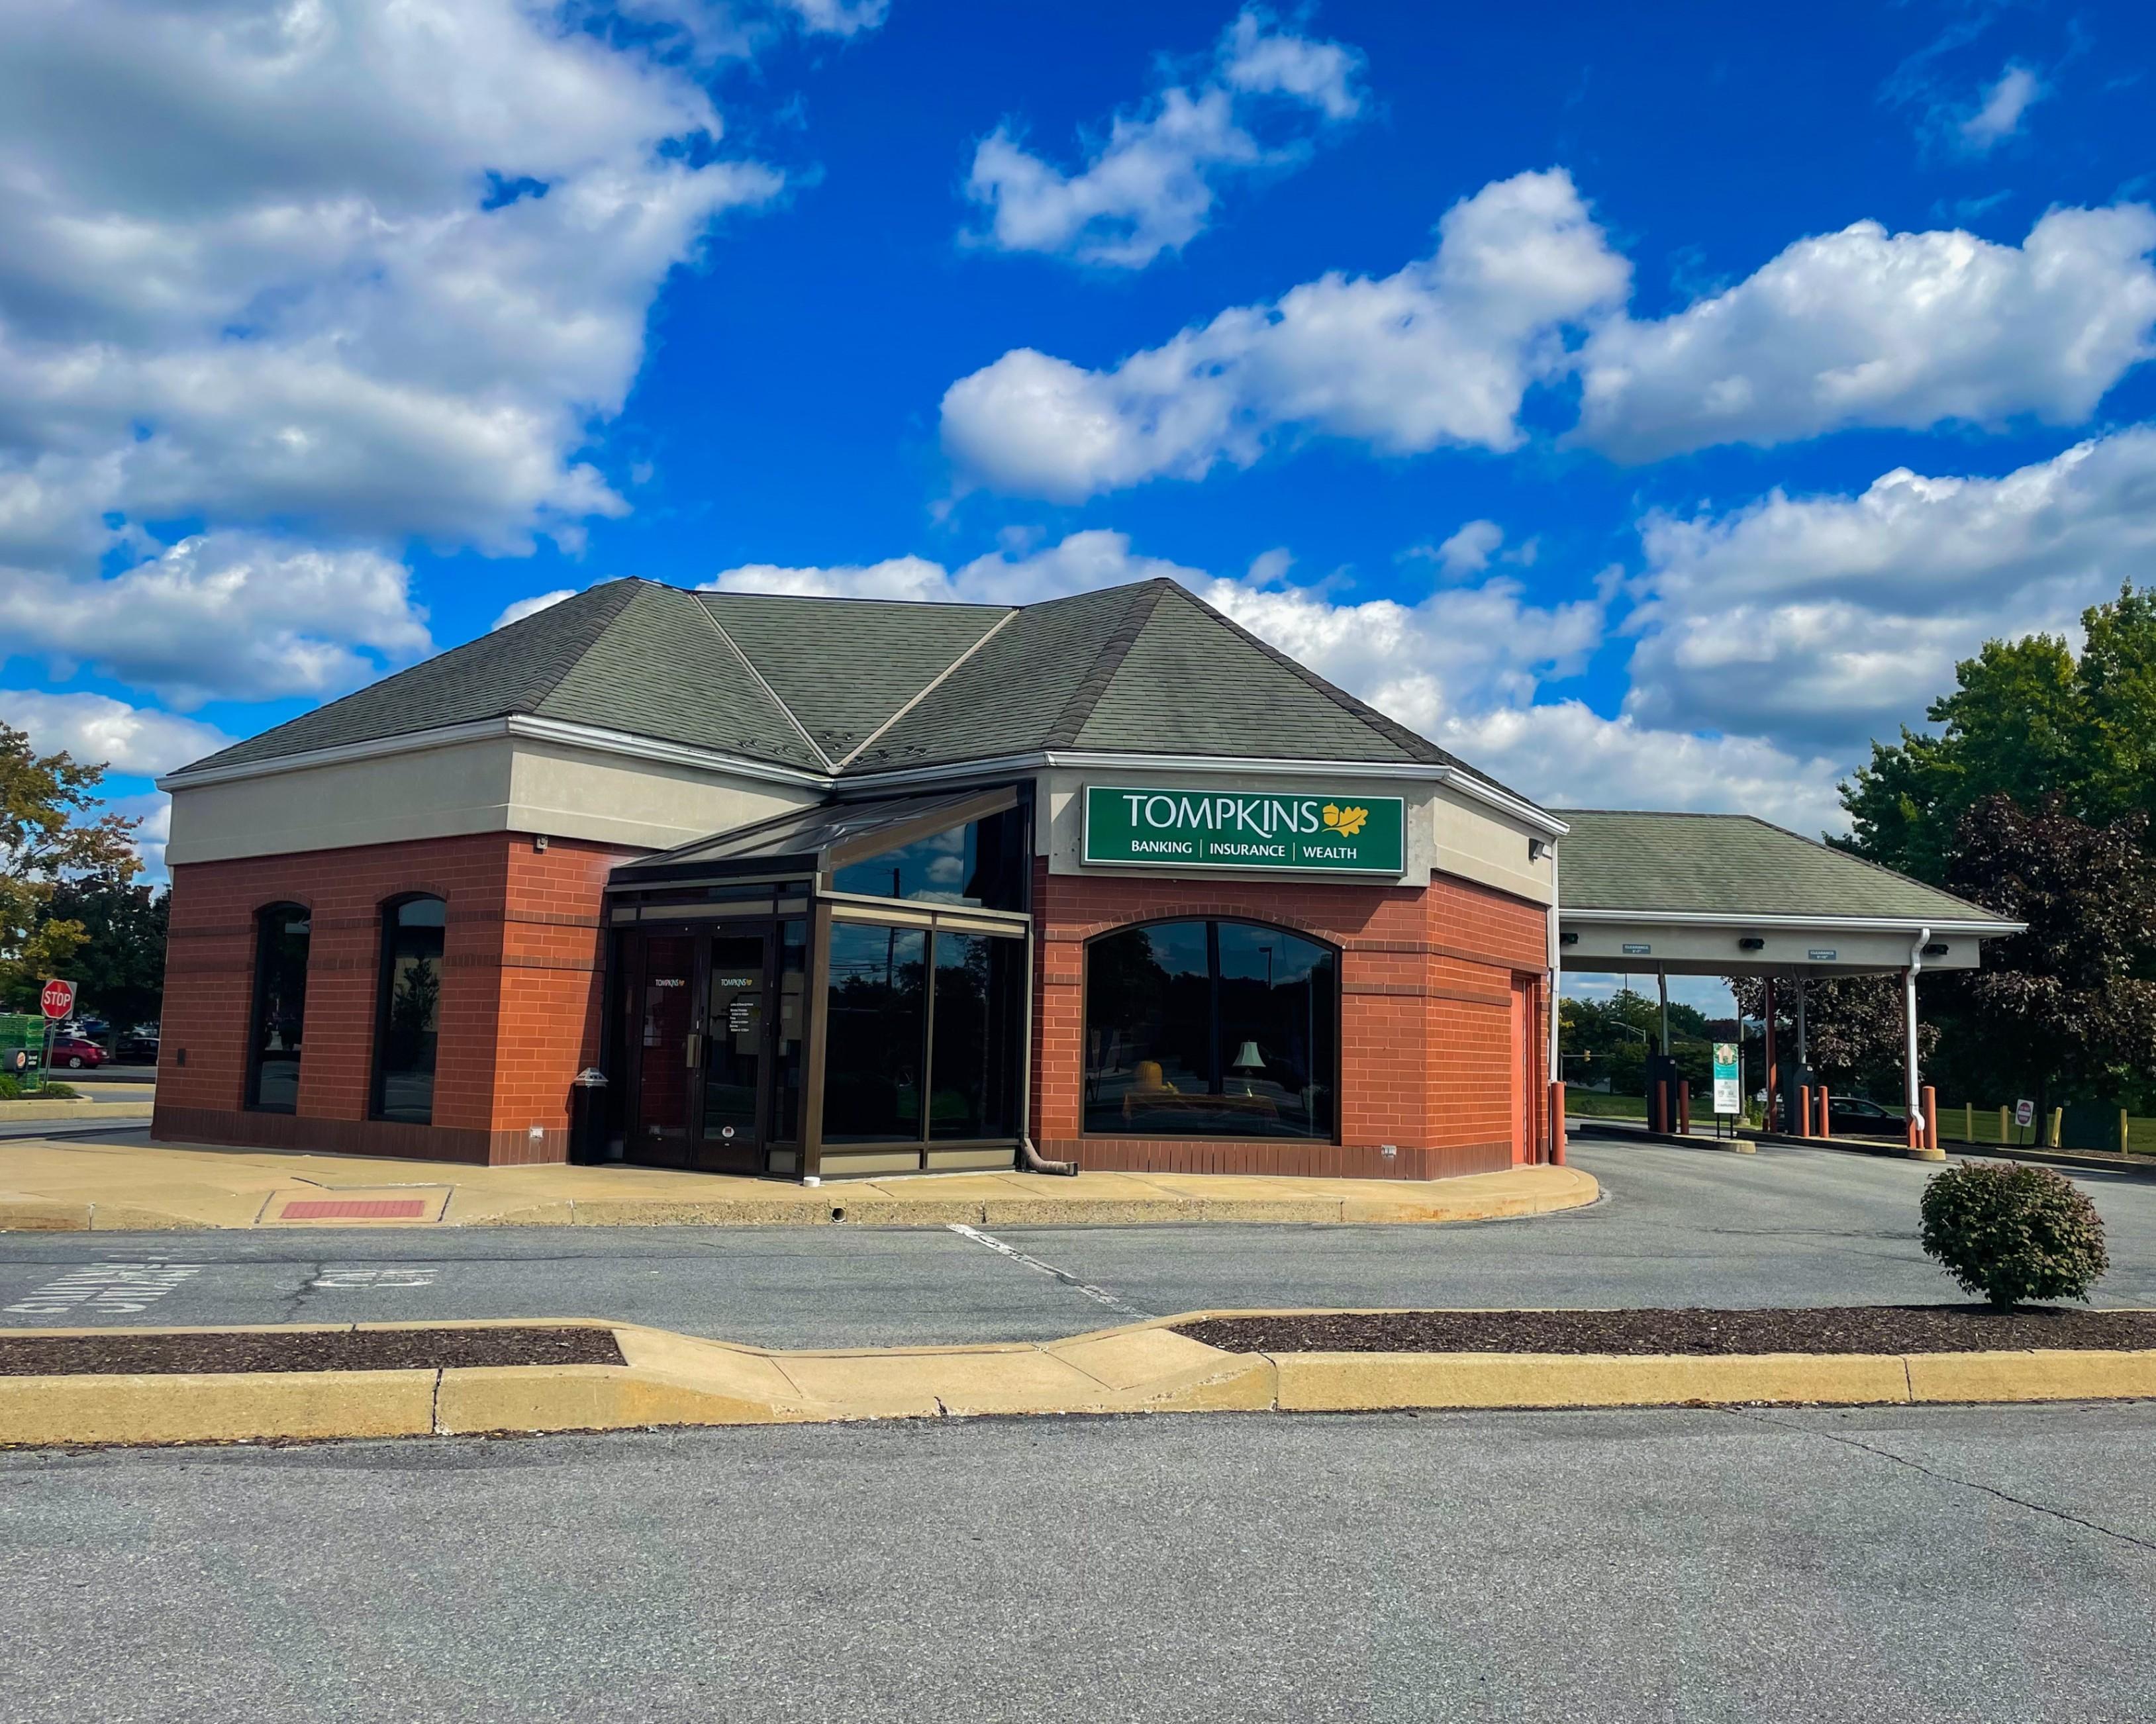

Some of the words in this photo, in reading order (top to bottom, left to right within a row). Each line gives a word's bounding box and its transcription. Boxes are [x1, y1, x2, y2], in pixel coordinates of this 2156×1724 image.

[1122, 795, 1320, 839] TOMPKINS
[1131, 839, 1193, 854] BANKING
[1210, 843, 1286, 857] INSURANCE
[1302, 845, 1357, 860] WEALTH
[656, 979, 679, 988] TOMPKINS
[720, 979, 747, 988] TOMPKINS
[44, 990, 72, 1007] STOP
